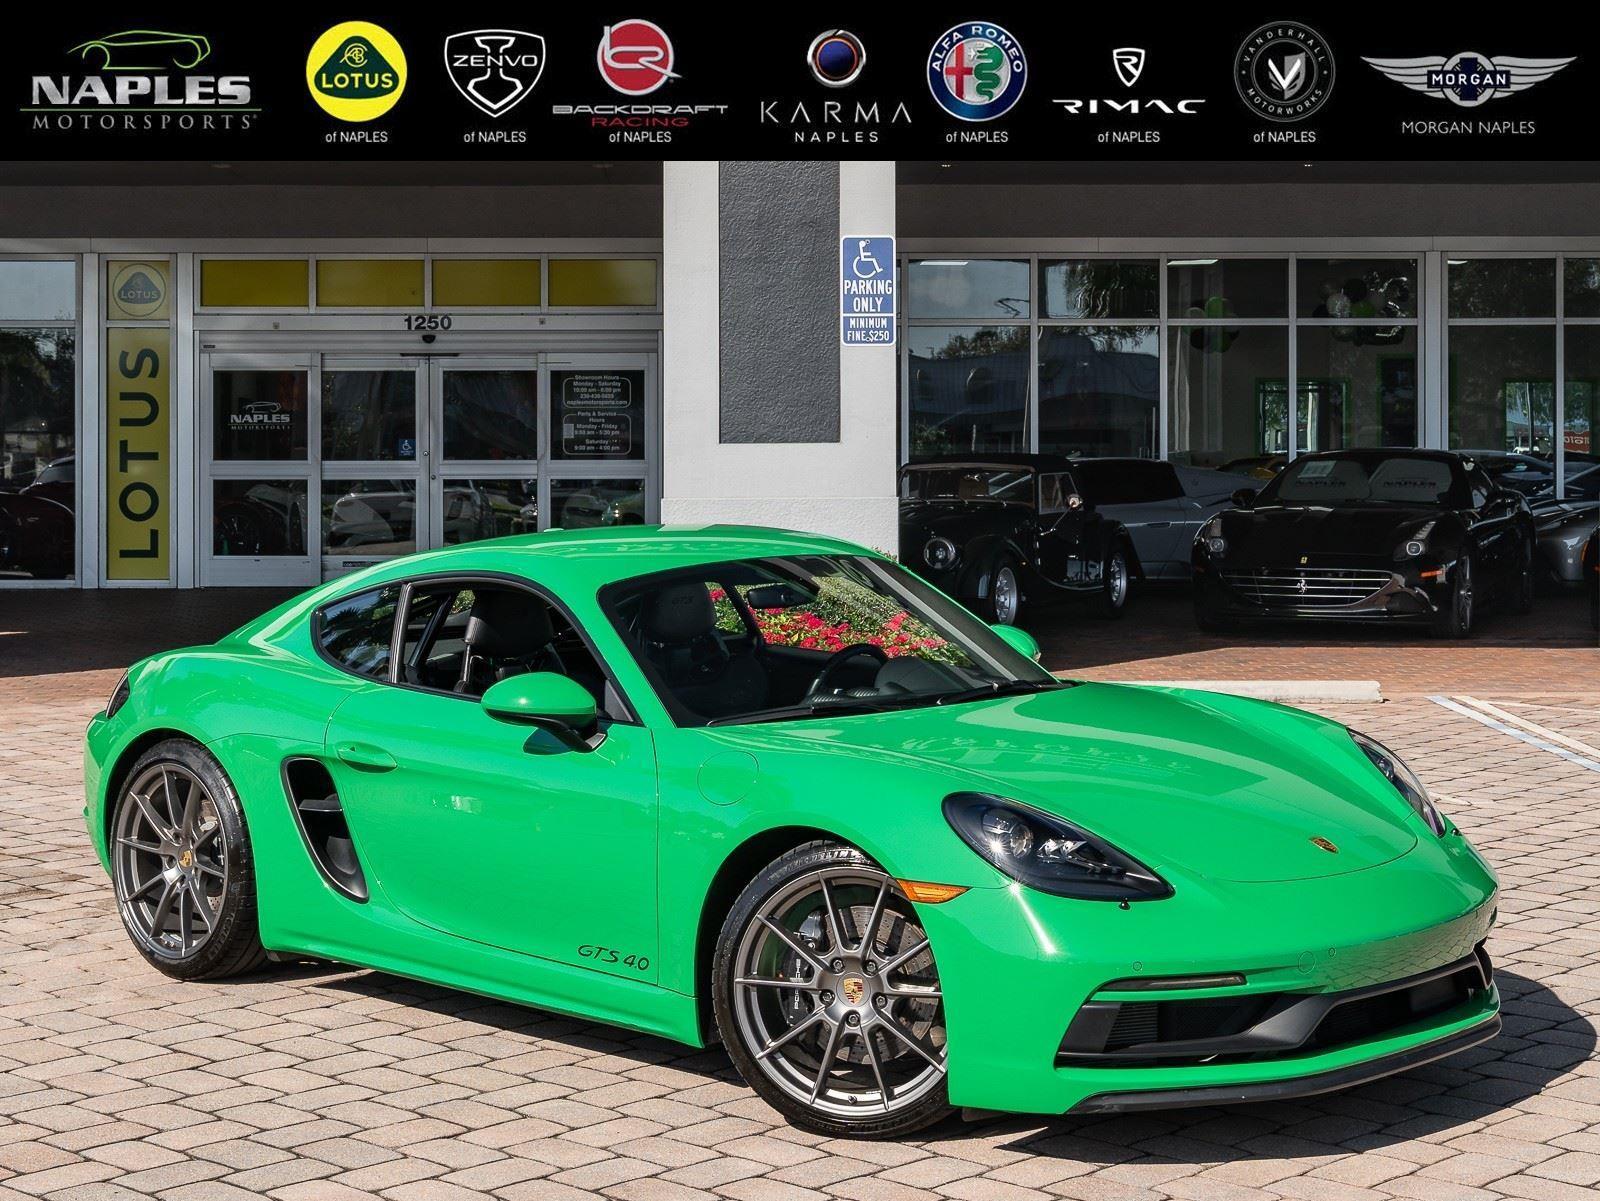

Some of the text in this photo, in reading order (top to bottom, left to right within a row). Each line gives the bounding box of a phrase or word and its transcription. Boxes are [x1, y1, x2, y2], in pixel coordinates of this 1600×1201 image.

[121, 290, 158, 299] LOTUS
[844, 280, 893, 295] PARKING
[853, 297, 883, 312] ONLY
[404, 314, 452, 330] 1250
[849, 318, 887, 328] MINIMUM
[847, 330, 890, 342] FINE $250
[230, 414, 290, 423] NAPLES
[119, 348, 160, 559] LOTUS
[577, 945, 650, 970] GTS 4.0
